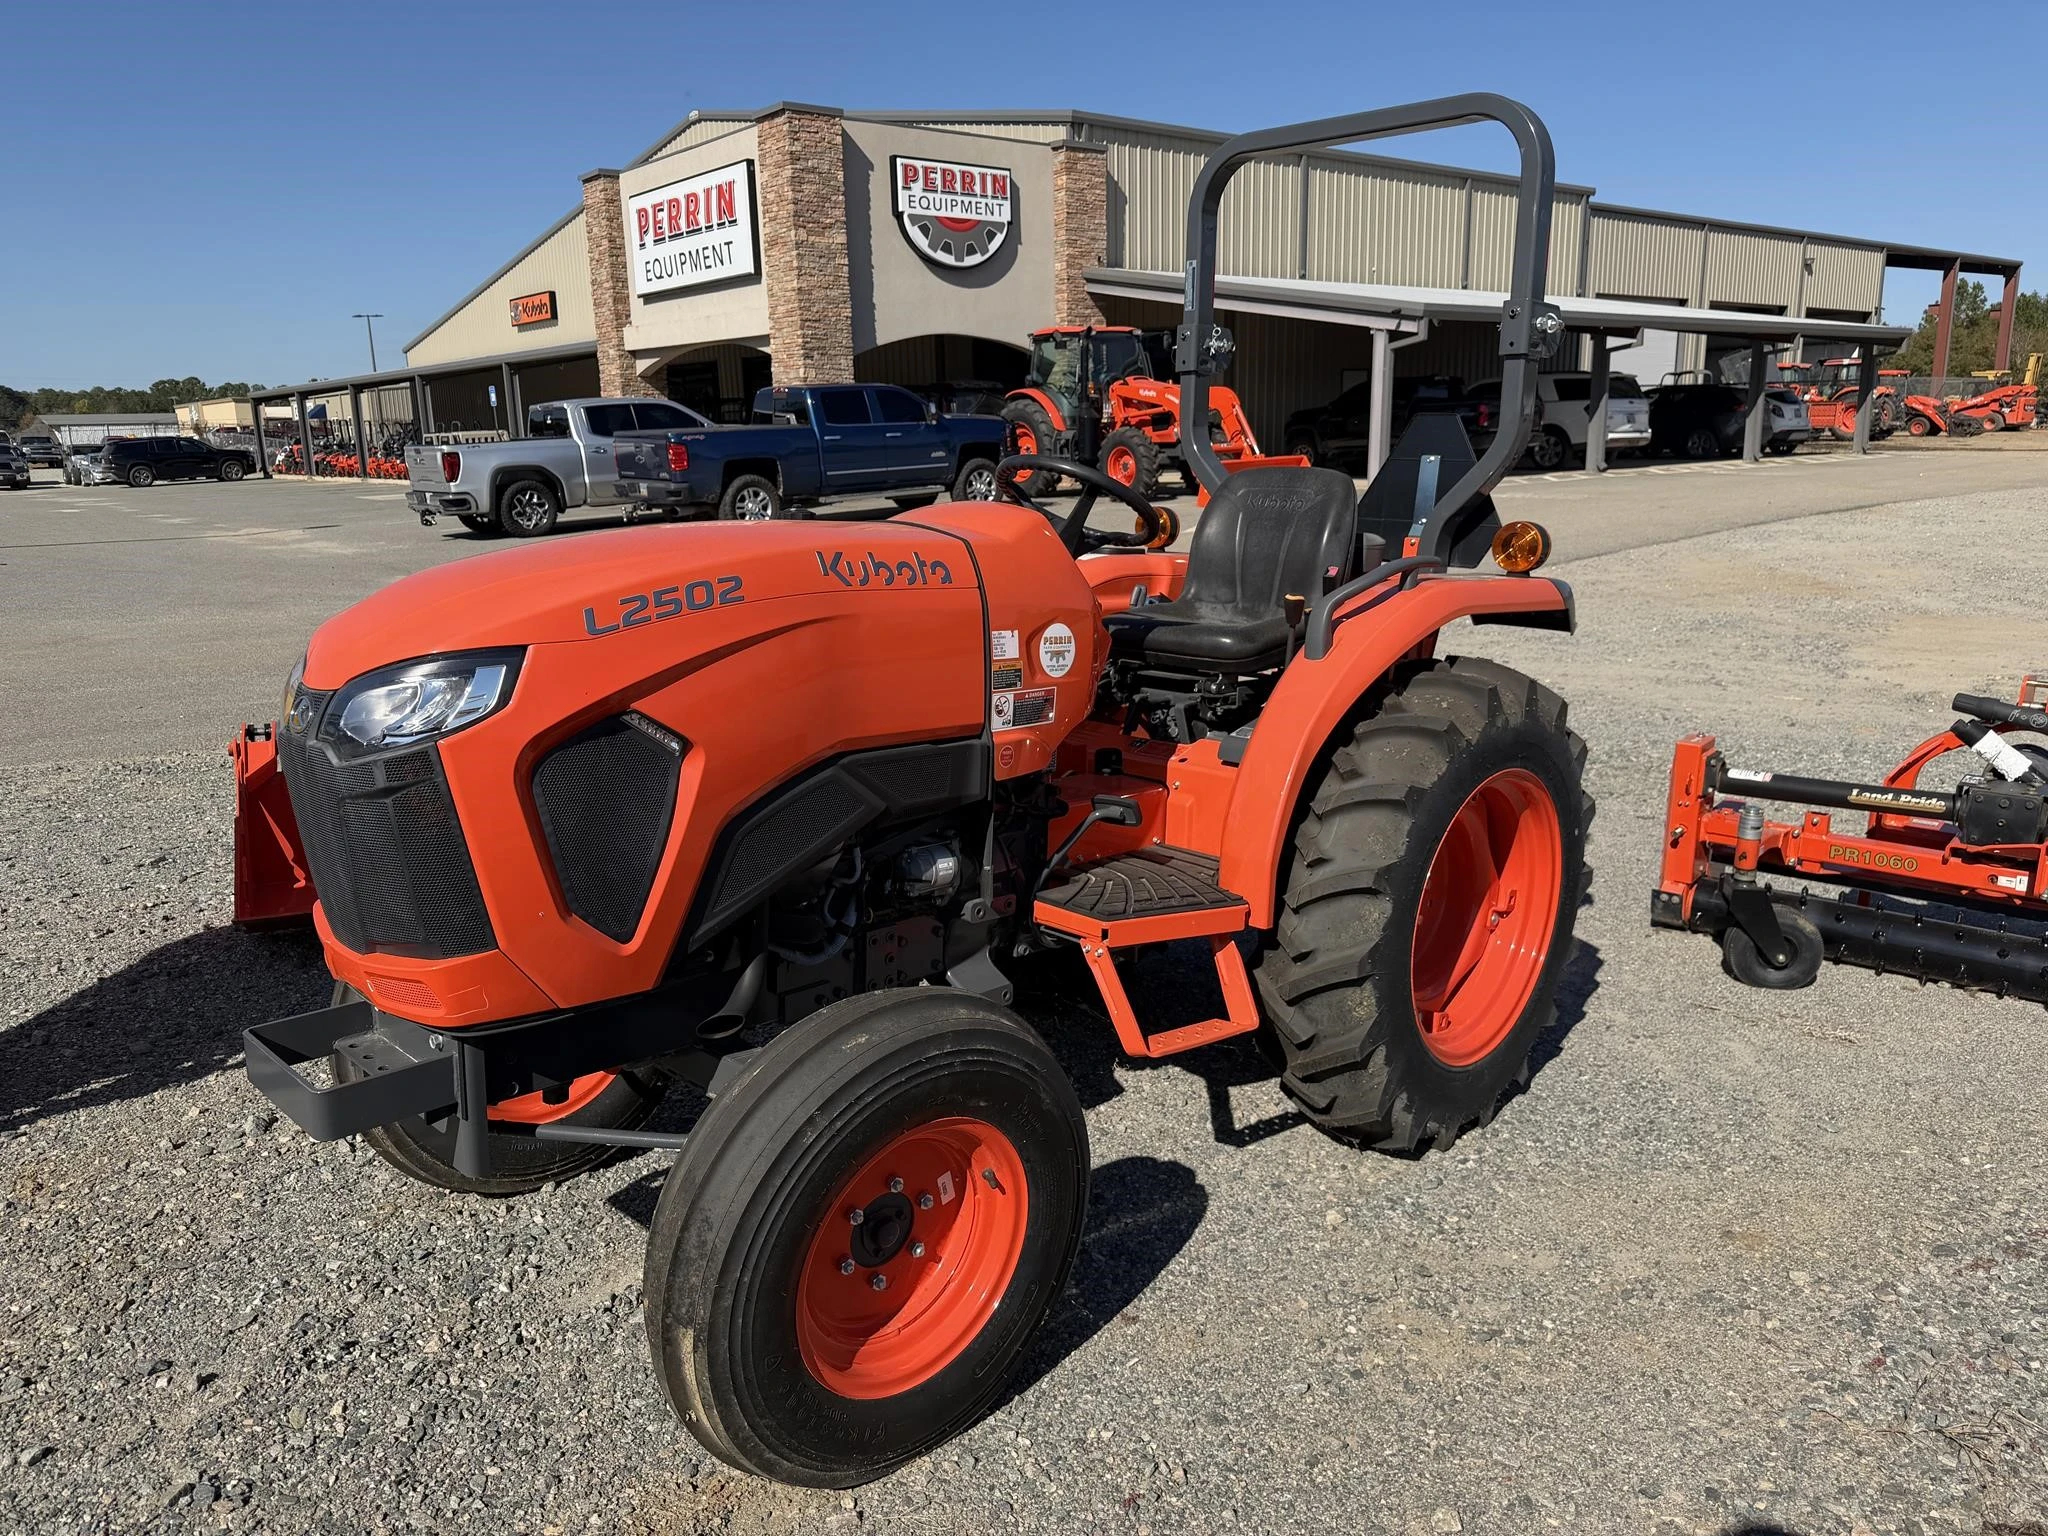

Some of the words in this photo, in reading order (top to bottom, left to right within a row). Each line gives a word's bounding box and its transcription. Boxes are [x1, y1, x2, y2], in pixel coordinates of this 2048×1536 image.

[901, 162, 1009, 199] PERRIN
[636, 179, 738, 249] PERRIN
[907, 193, 1005, 217] EQUIPMENT
[644, 240, 734, 282] EQUIPMENT
[1247, 493, 1305, 511] Kubota
[815, 550, 953, 587] Kubota
[583, 575, 745, 636] L2502
[1043, 635, 1072, 646] PERRIN
[1850, 788, 1894, 801] Land
[1898, 793, 1946, 808] Pride
[1829, 844, 1918, 872] PR1060
